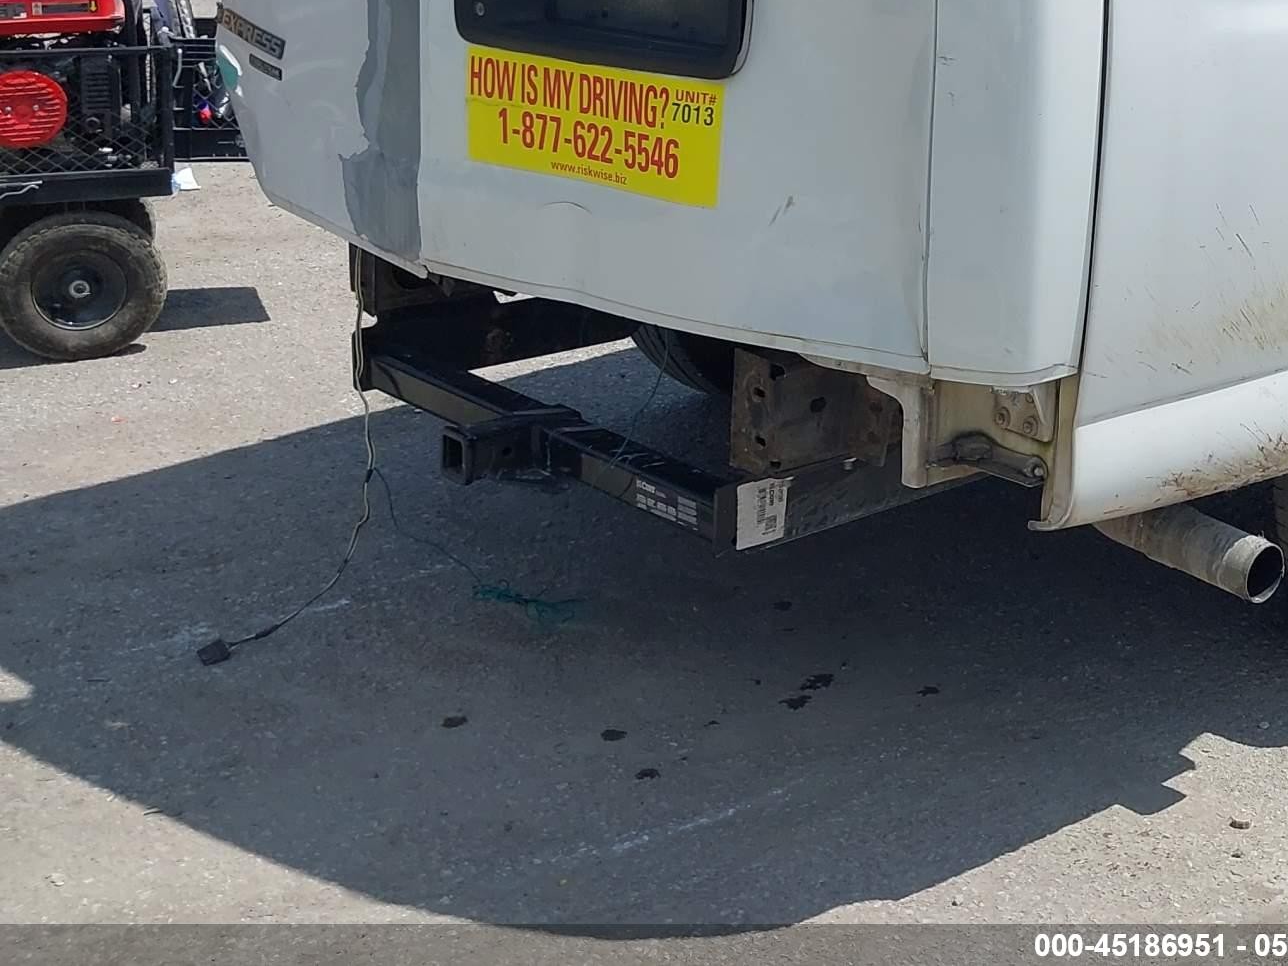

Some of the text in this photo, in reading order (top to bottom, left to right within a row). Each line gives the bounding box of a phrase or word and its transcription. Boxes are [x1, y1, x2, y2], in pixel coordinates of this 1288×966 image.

[222, 9, 284, 59] EXPRESS
[470, 55, 670, 130] HOW IS MY DRIVING?
[675, 89, 718, 106] UNIT#
[671, 102, 715, 126] 7013
[498, 107, 680, 179] 1-877-622-5546
[550, 160, 628, 185] www.riskwise.biz
